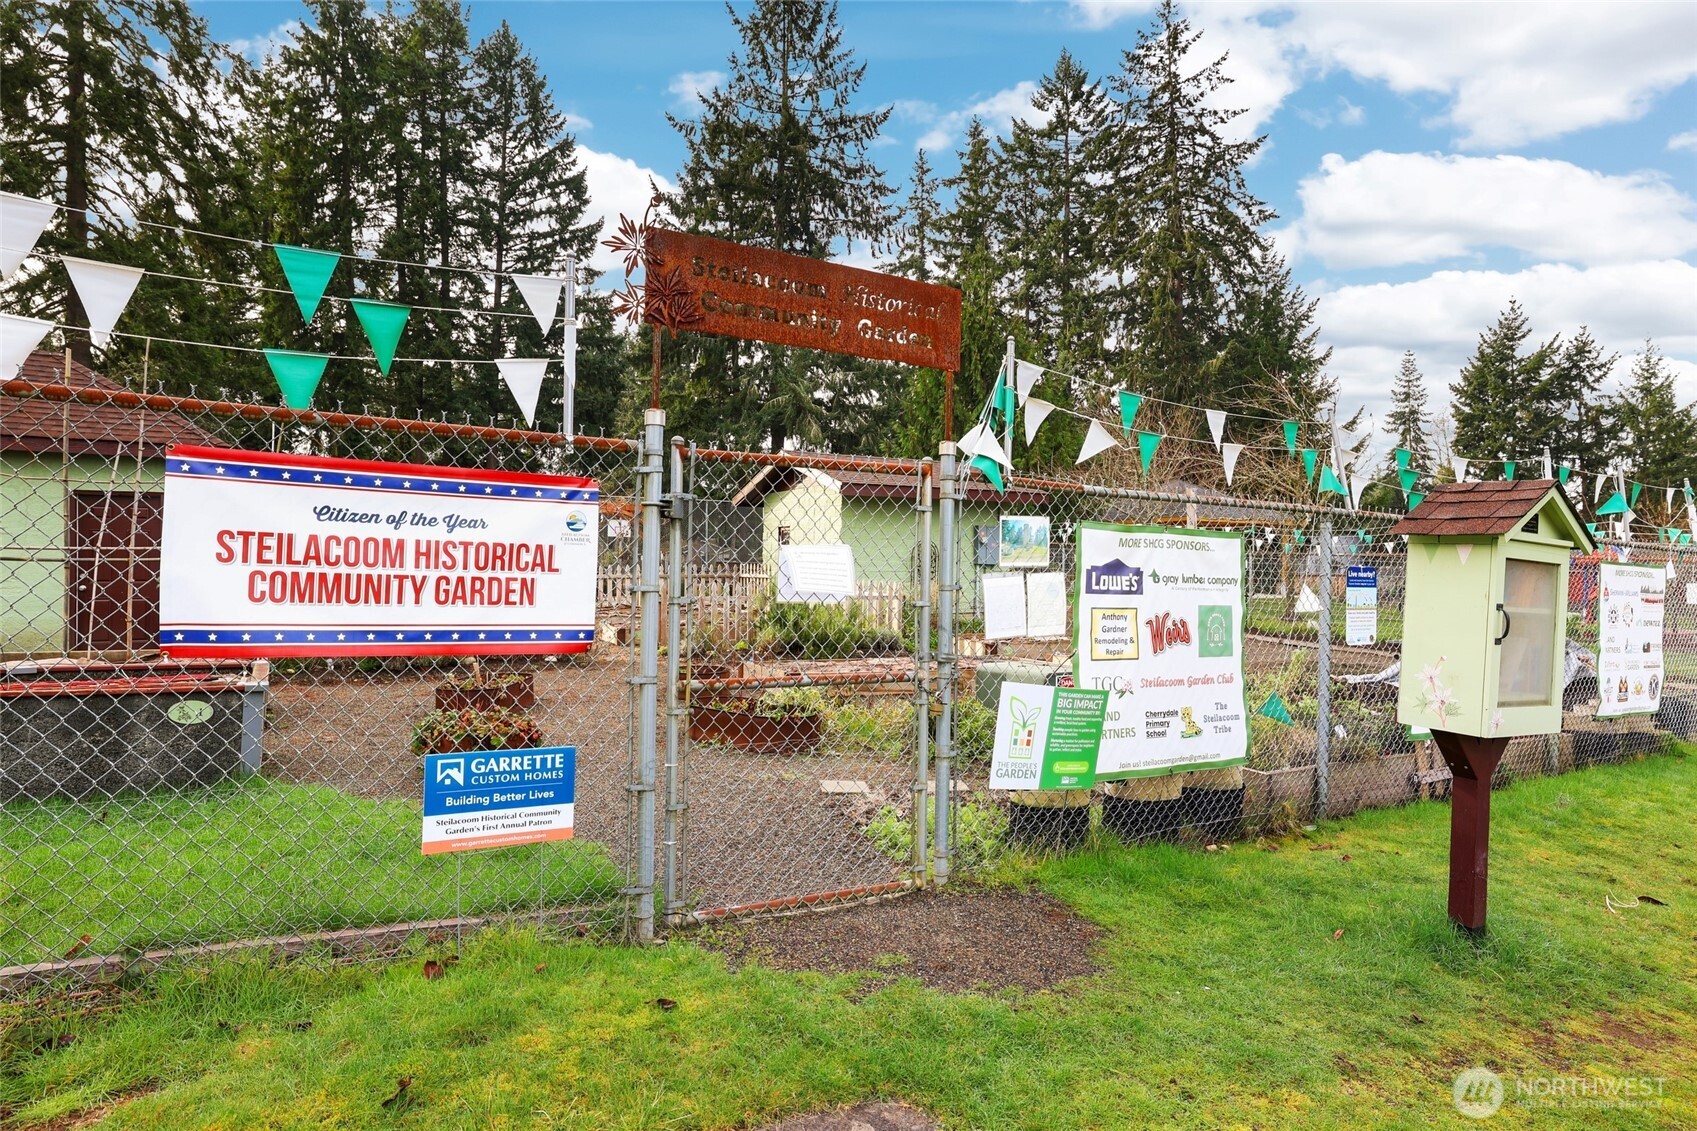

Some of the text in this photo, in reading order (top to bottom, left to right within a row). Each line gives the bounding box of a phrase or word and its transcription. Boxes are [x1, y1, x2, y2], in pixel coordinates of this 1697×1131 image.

[690, 256, 946, 320] Steilacoom Historical
[701, 291, 932, 350] Community Garden
[312, 504, 488, 532] Citizen of the Year
[1118, 538, 1142, 548] MORE
[1144, 539, 1164, 549] SHCG
[216, 529, 560, 574] STEILACOOM HISTORICAL
[1092, 572, 1138, 591] LOWE'S
[1162, 573, 1238, 586] gray lumber company
[1358, 570, 1375, 579] nearby?
[248, 570, 536, 606] COMMUNITY GARDEN
[1102, 613, 1127, 622] Anthony
[1094, 637, 1128, 645] Remodeling
[1092, 676, 1123, 691] TGC
[1140, 673, 1234, 688] Steilacoom Garden Club
[1057, 698, 1103, 709] BIG IMPACT
[1214, 702, 1228, 710] The
[1145, 709, 1178, 719] Cherrydale
[1203, 713, 1240, 723] Steilacoom
[1146, 719, 1170, 728] Primary
[1214, 726, 1232, 734] Tribe
[1101, 728, 1136, 740] RTNERS
[1146, 730, 1167, 738] School
[471, 754, 564, 773] GARRETTE
[1118, 761, 1132, 769] Join
[1142, 752, 1221, 767] steilacoomgarden@gmail.com
[471, 770, 564, 785] CUSTOM HOMES
[996, 769, 1037, 779] GARDEN
[446, 790, 554, 806] Building Better Lives
[436, 808, 561, 826] Steilacoom Historical Community
[445, 818, 552, 835] Garden's First Annual Patron
[452, 833, 547, 847] www.garrettecustomhomes.com
